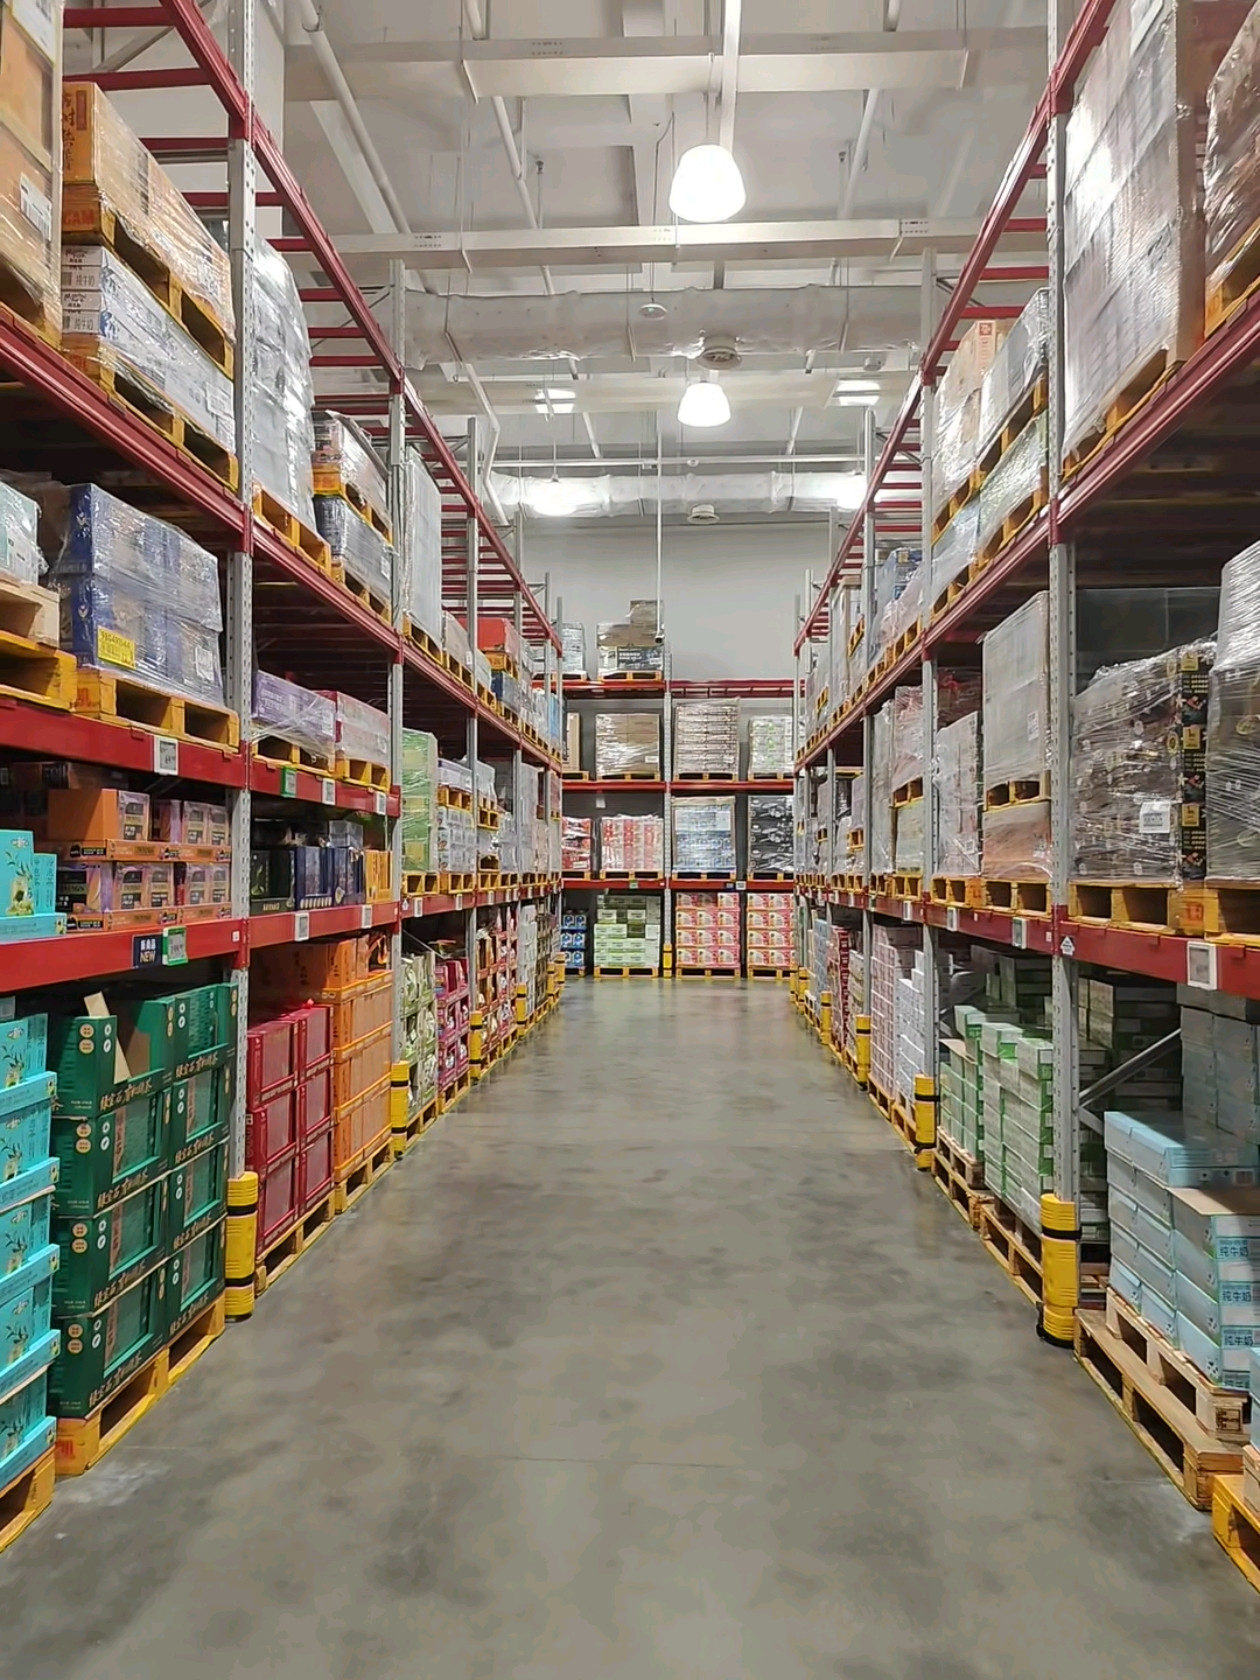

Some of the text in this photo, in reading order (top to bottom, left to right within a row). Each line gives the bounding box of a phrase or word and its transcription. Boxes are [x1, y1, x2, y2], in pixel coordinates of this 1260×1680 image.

[140, 950, 156, 963] NEW
[1222, 1291, 1252, 1302] 纯牛奶
[1224, 1335, 1254, 1346] 纯牛奶
